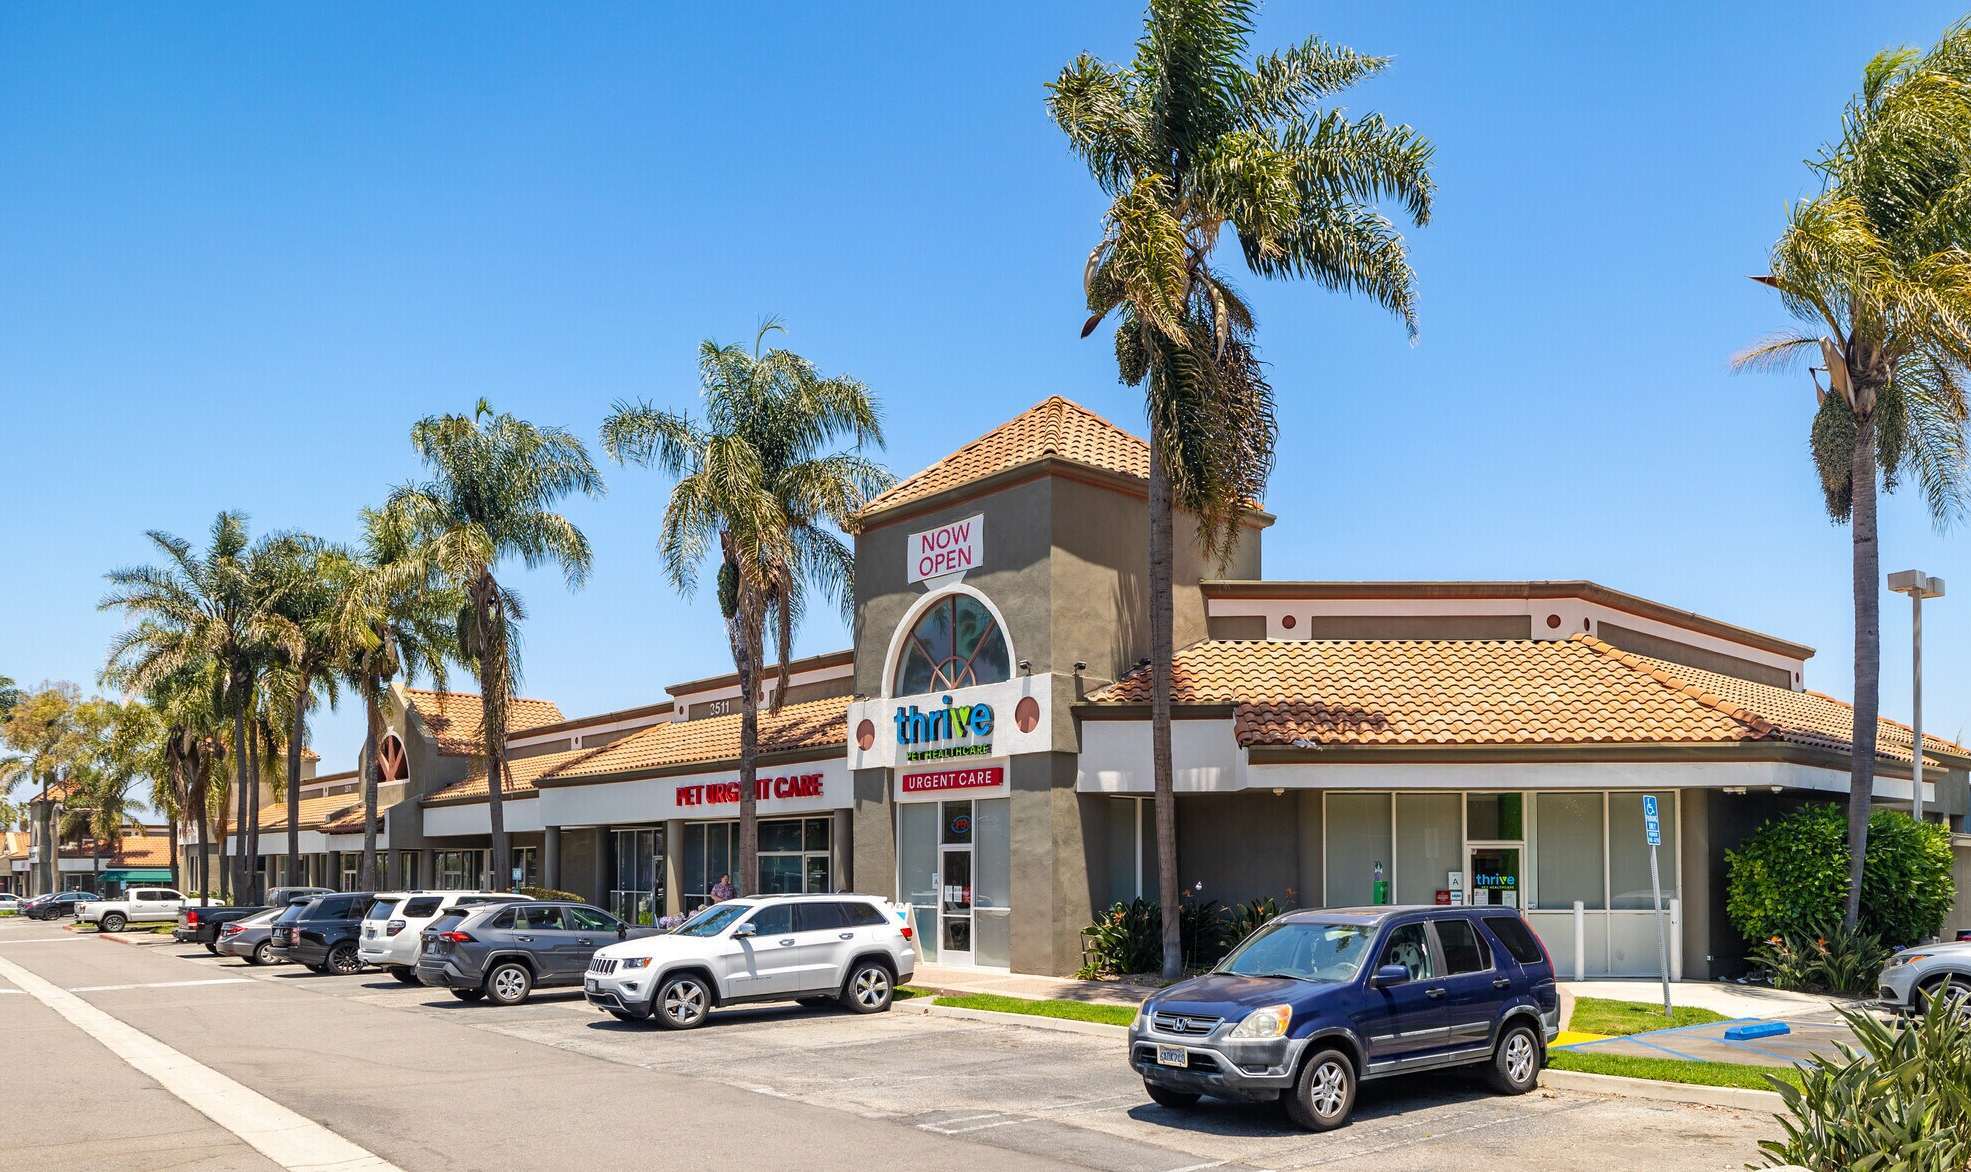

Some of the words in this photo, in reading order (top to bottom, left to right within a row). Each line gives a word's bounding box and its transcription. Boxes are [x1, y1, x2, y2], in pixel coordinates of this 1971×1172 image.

[921, 522, 971, 554] NOW
[919, 544, 972, 577] OPEN
[710, 700, 730, 716] 3511
[894, 695, 994, 745] thrive
[906, 751, 925, 761] PET
[925, 744, 992, 760] HEALTHCARE
[675, 784, 705, 806] PET
[774, 773, 824, 799] CARE
[908, 773, 956, 790] URGENT
[958, 770, 992, 786] CARE
[1476, 872, 1515, 886] thrive
